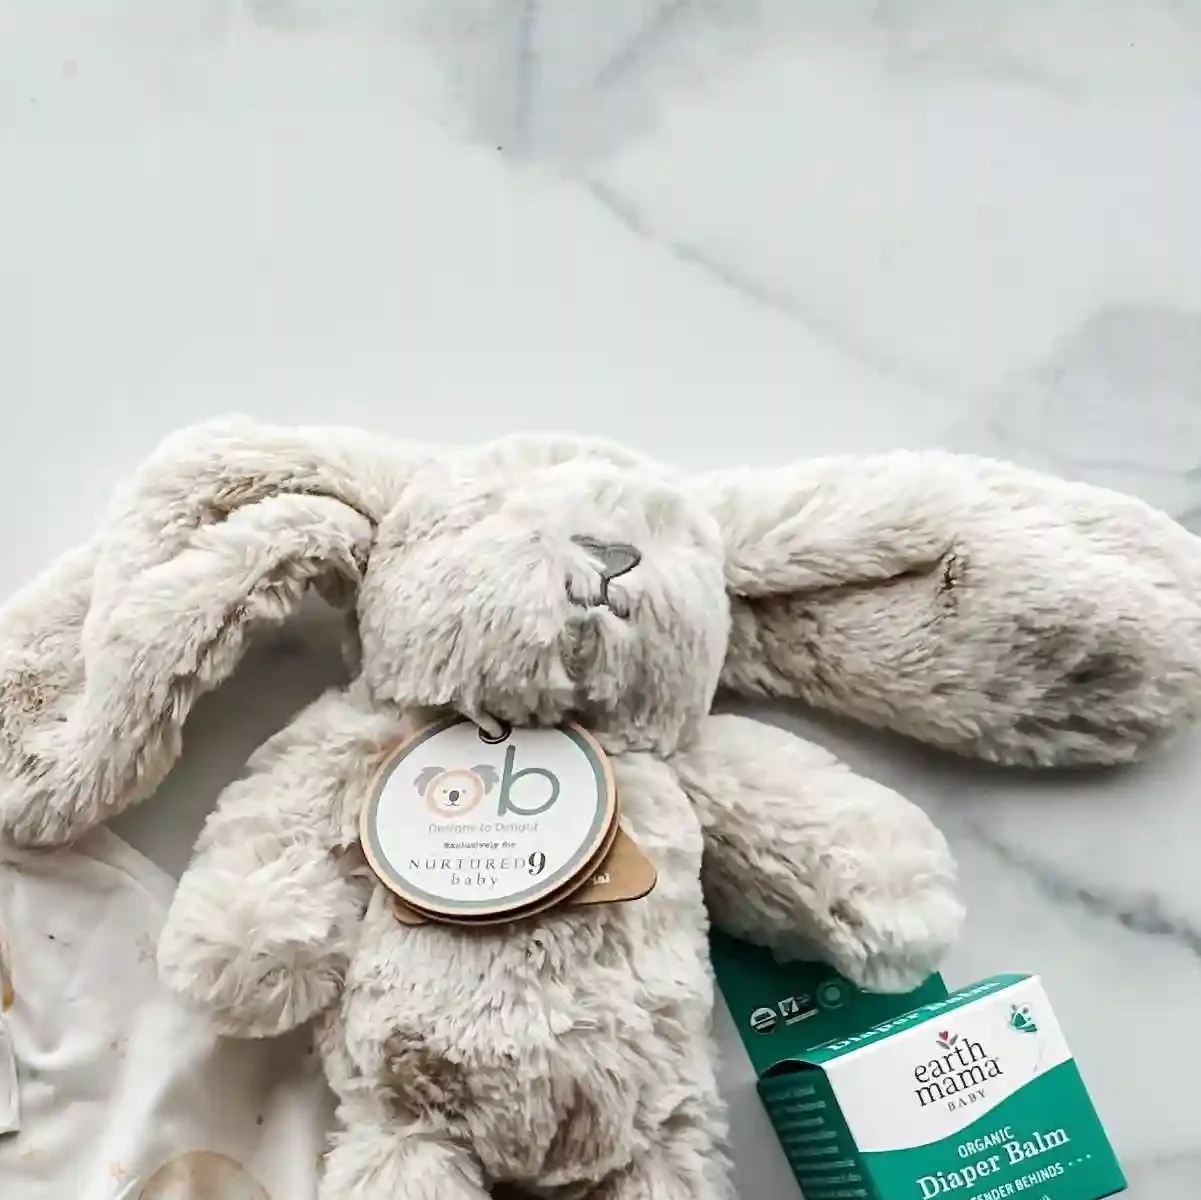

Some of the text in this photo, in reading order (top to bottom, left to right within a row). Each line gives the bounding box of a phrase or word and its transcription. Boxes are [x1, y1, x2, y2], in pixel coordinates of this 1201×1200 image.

[479, 823, 492, 833] to
[451, 872, 498, 889] baby
[914, 1037, 987, 1083] earth
[914, 1058, 1004, 1107] mama
[947, 1088, 986, 1112] BABY
[957, 1125, 1016, 1158] ORGANIC
[915, 1127, 1071, 1200] Diaper Balm
[1014, 1162, 1065, 1191] BEHINDS
